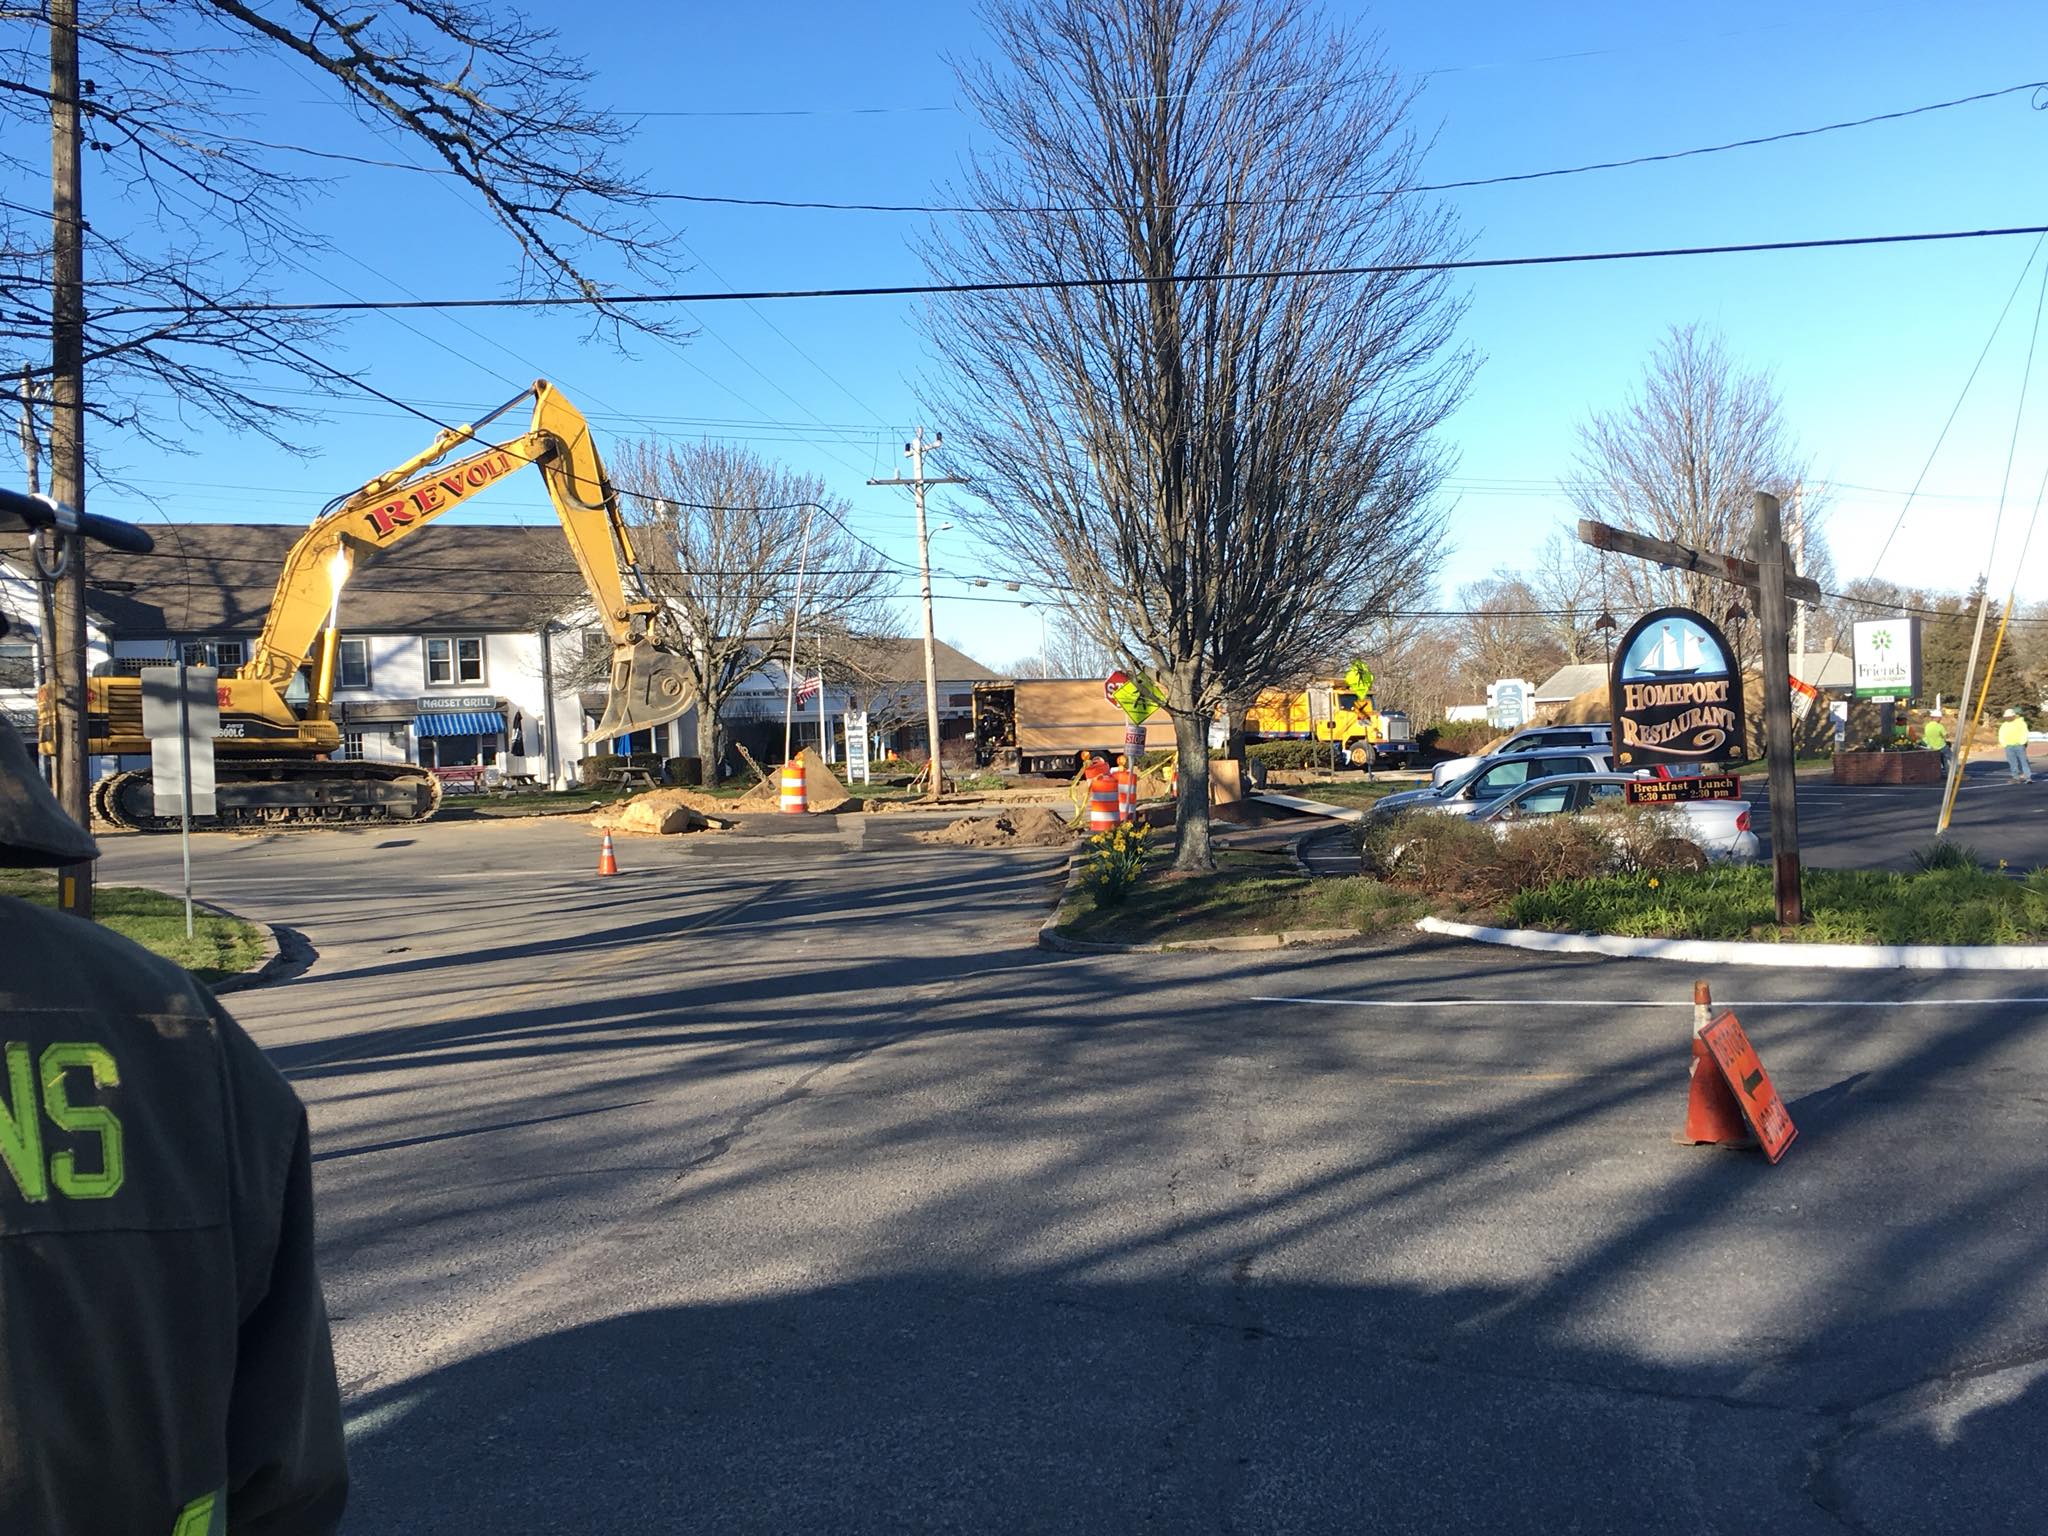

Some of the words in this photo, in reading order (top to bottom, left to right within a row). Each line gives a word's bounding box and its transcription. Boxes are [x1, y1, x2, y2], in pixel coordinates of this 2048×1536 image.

[363, 453, 512, 540] REVOLI
[1858, 662, 1906, 678] Friends
[422, 699, 462, 709] NAUSET
[463, 697, 491, 707] GRILL
[1623, 681, 1730, 712] HOMEPORT
[1620, 706, 1736, 747] RESTAURANT
[1127, 734, 1144, 744] STOP
[1633, 781, 1689, 793] Breakfast
[1699, 778, 1734, 789] Lunch
[1638, 792, 1658, 802] 5:30
[1661, 792, 1677, 800] am
[1690, 789, 1709, 799] 2:30
[1713, 789, 1729, 799] pm
